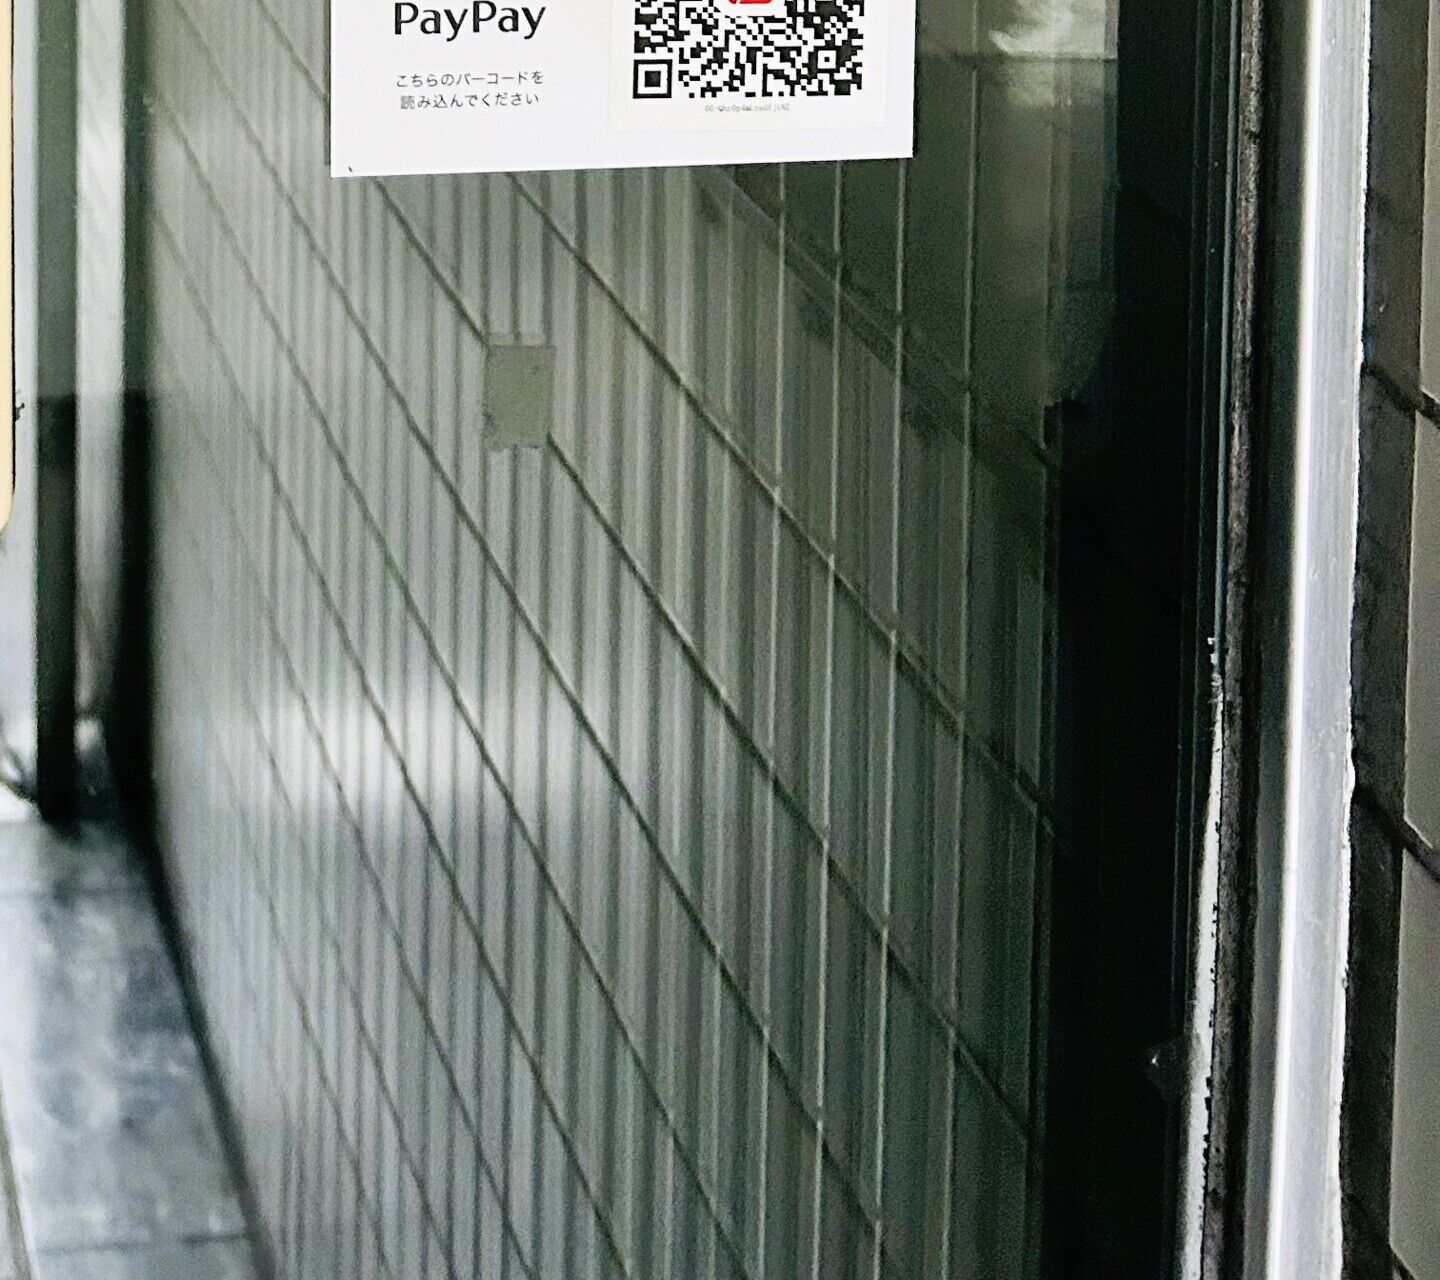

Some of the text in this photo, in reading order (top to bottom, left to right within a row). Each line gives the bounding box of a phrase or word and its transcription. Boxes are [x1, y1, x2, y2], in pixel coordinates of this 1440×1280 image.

[395, 0, 546, 42] PayPay
[394, 68, 545, 89] こちらのバーコードを
[398, 90, 541, 111] 読み込んでください
